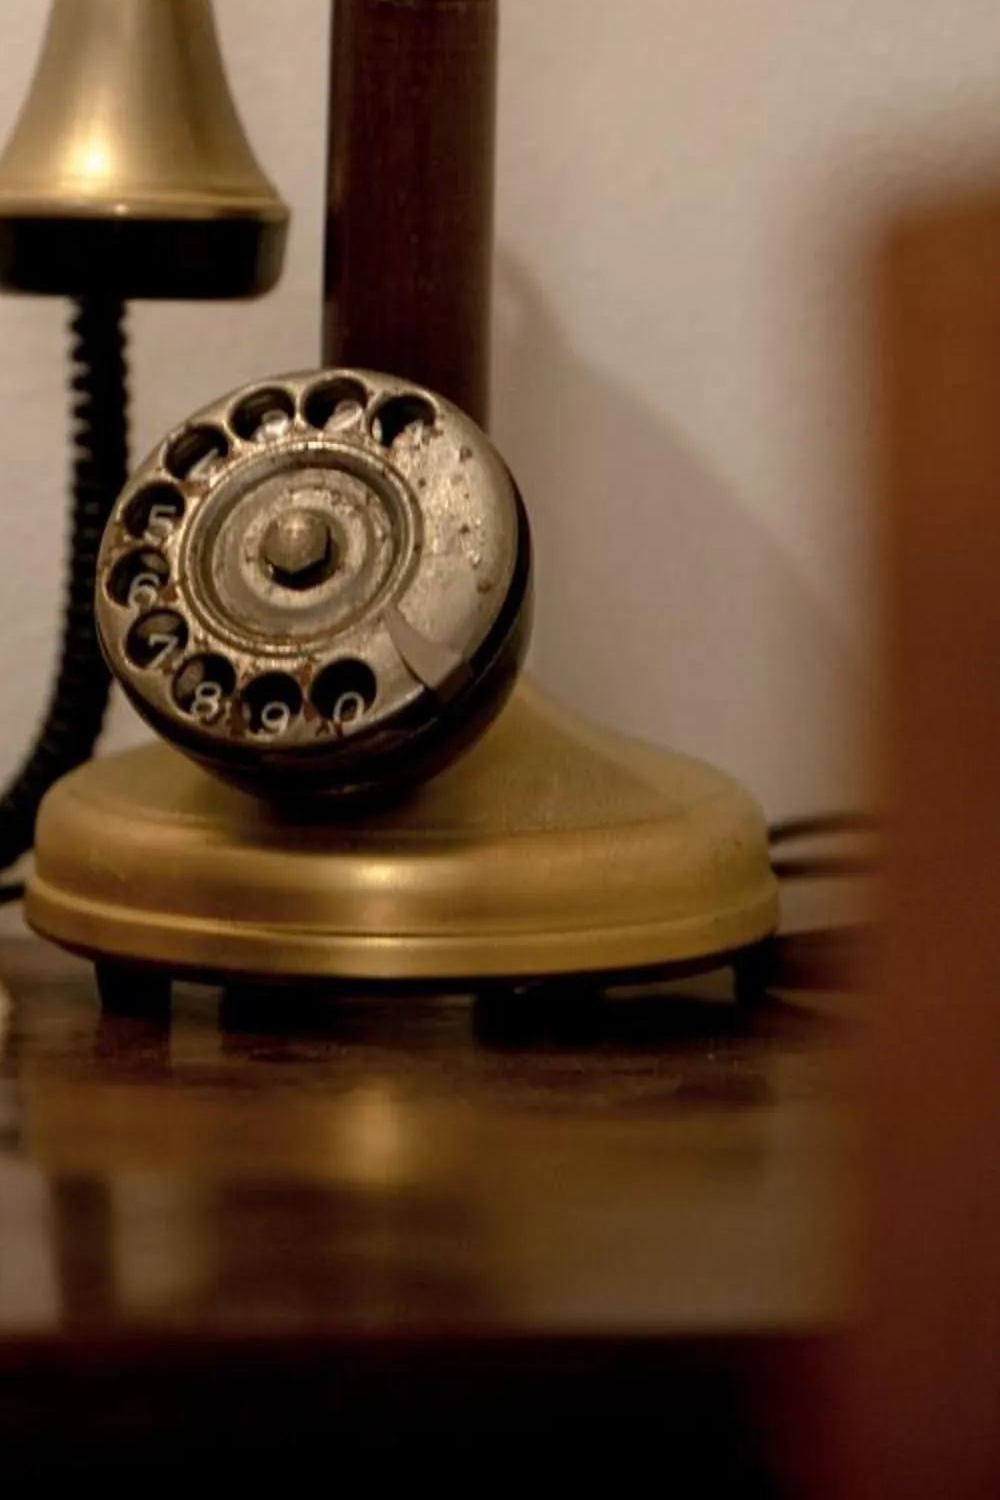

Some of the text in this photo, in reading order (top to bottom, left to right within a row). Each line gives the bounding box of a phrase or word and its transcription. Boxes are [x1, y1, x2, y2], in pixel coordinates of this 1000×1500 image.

[148, 504, 177, 546] 5
[127, 573, 161, 609] 6
[148, 633, 179, 668] 7
[191, 682, 223, 717] 8
[333, 691, 365, 725] 0
[261, 701, 291, 735] 9
